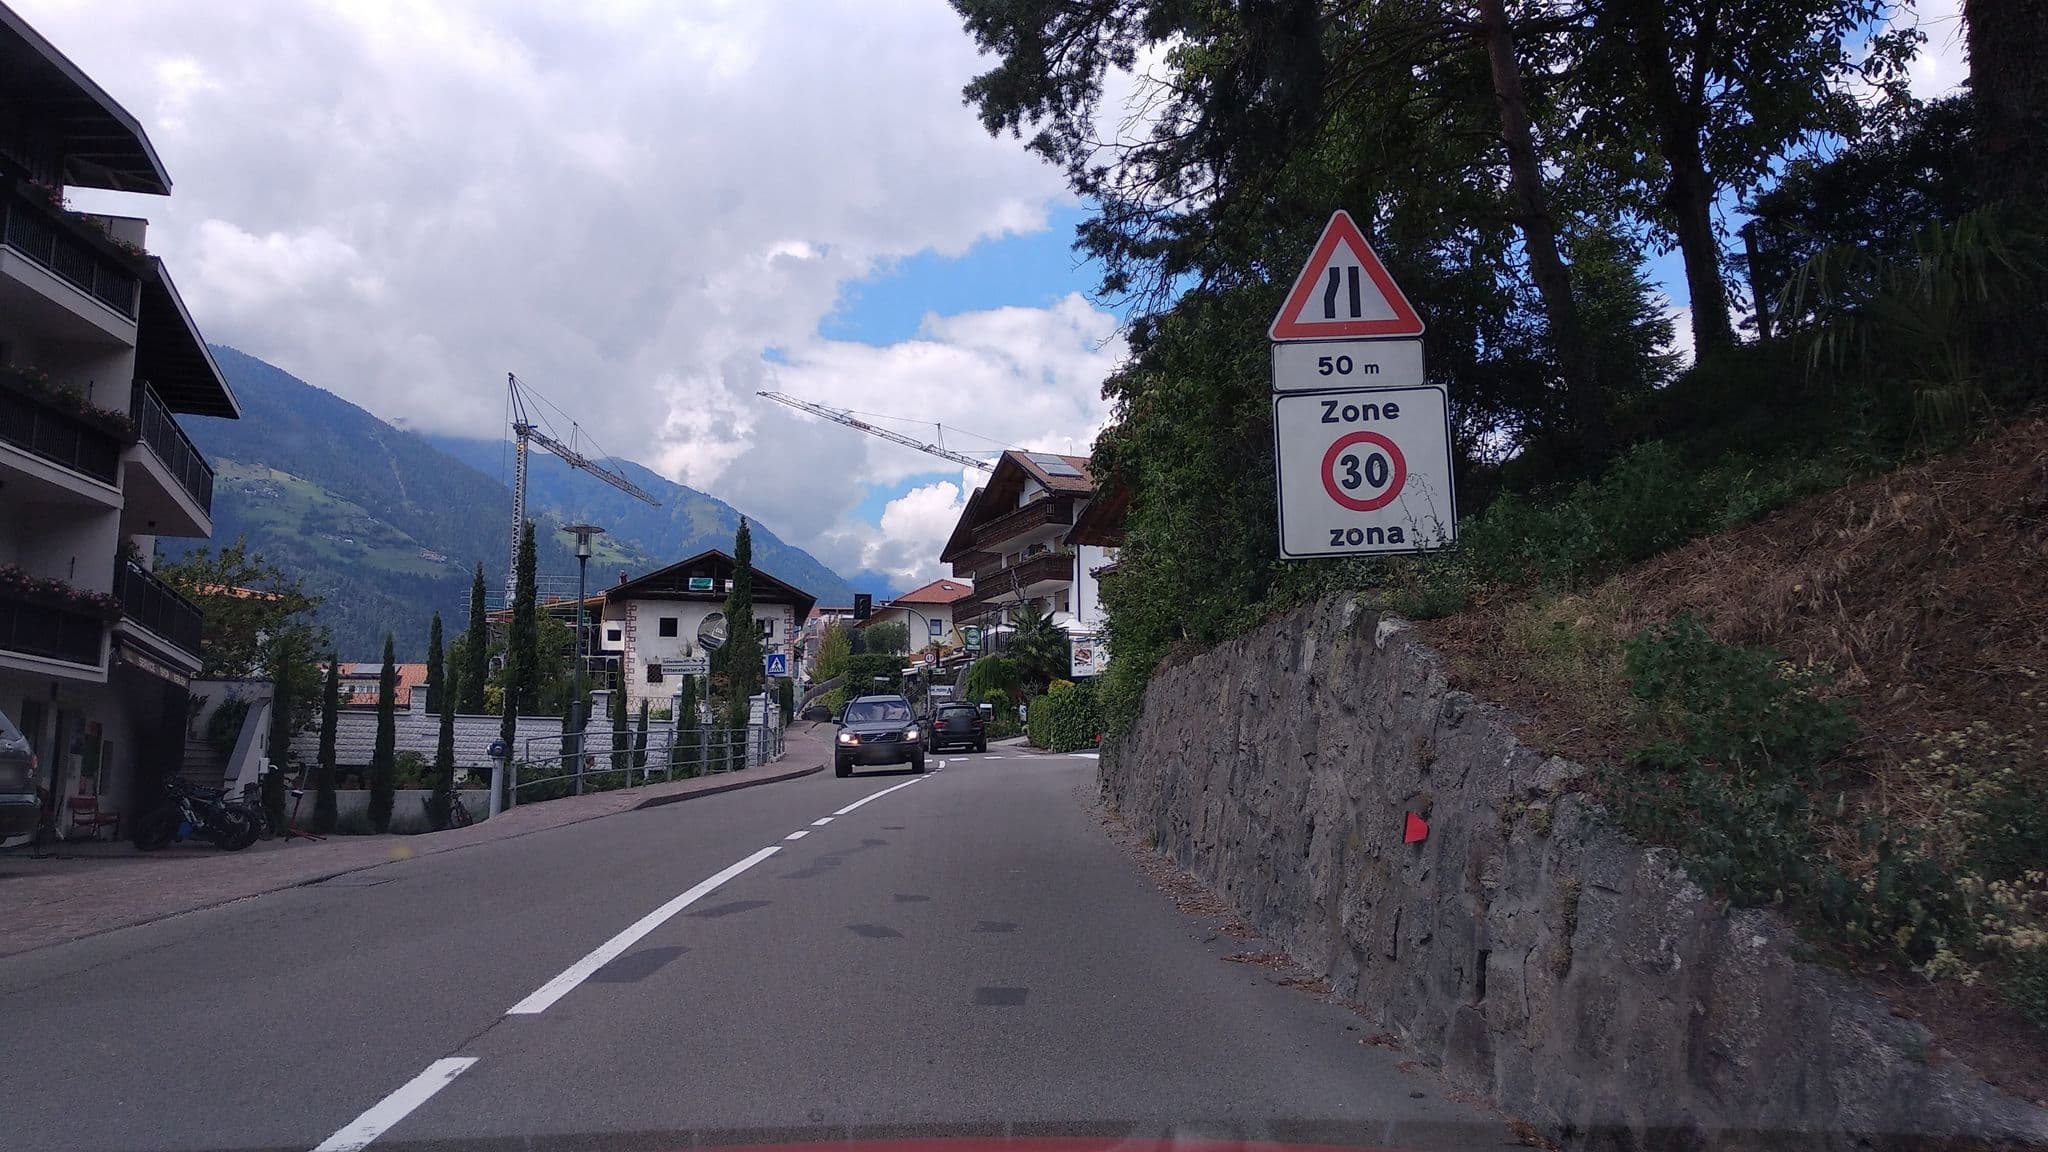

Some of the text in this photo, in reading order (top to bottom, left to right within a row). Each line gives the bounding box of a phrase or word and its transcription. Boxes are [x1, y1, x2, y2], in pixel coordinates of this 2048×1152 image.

[1318, 355, 1380, 376] 50 m
[1321, 400, 1400, 424] Zone
[1340, 453, 1388, 489] 30
[1330, 525, 1405, 547] zona
